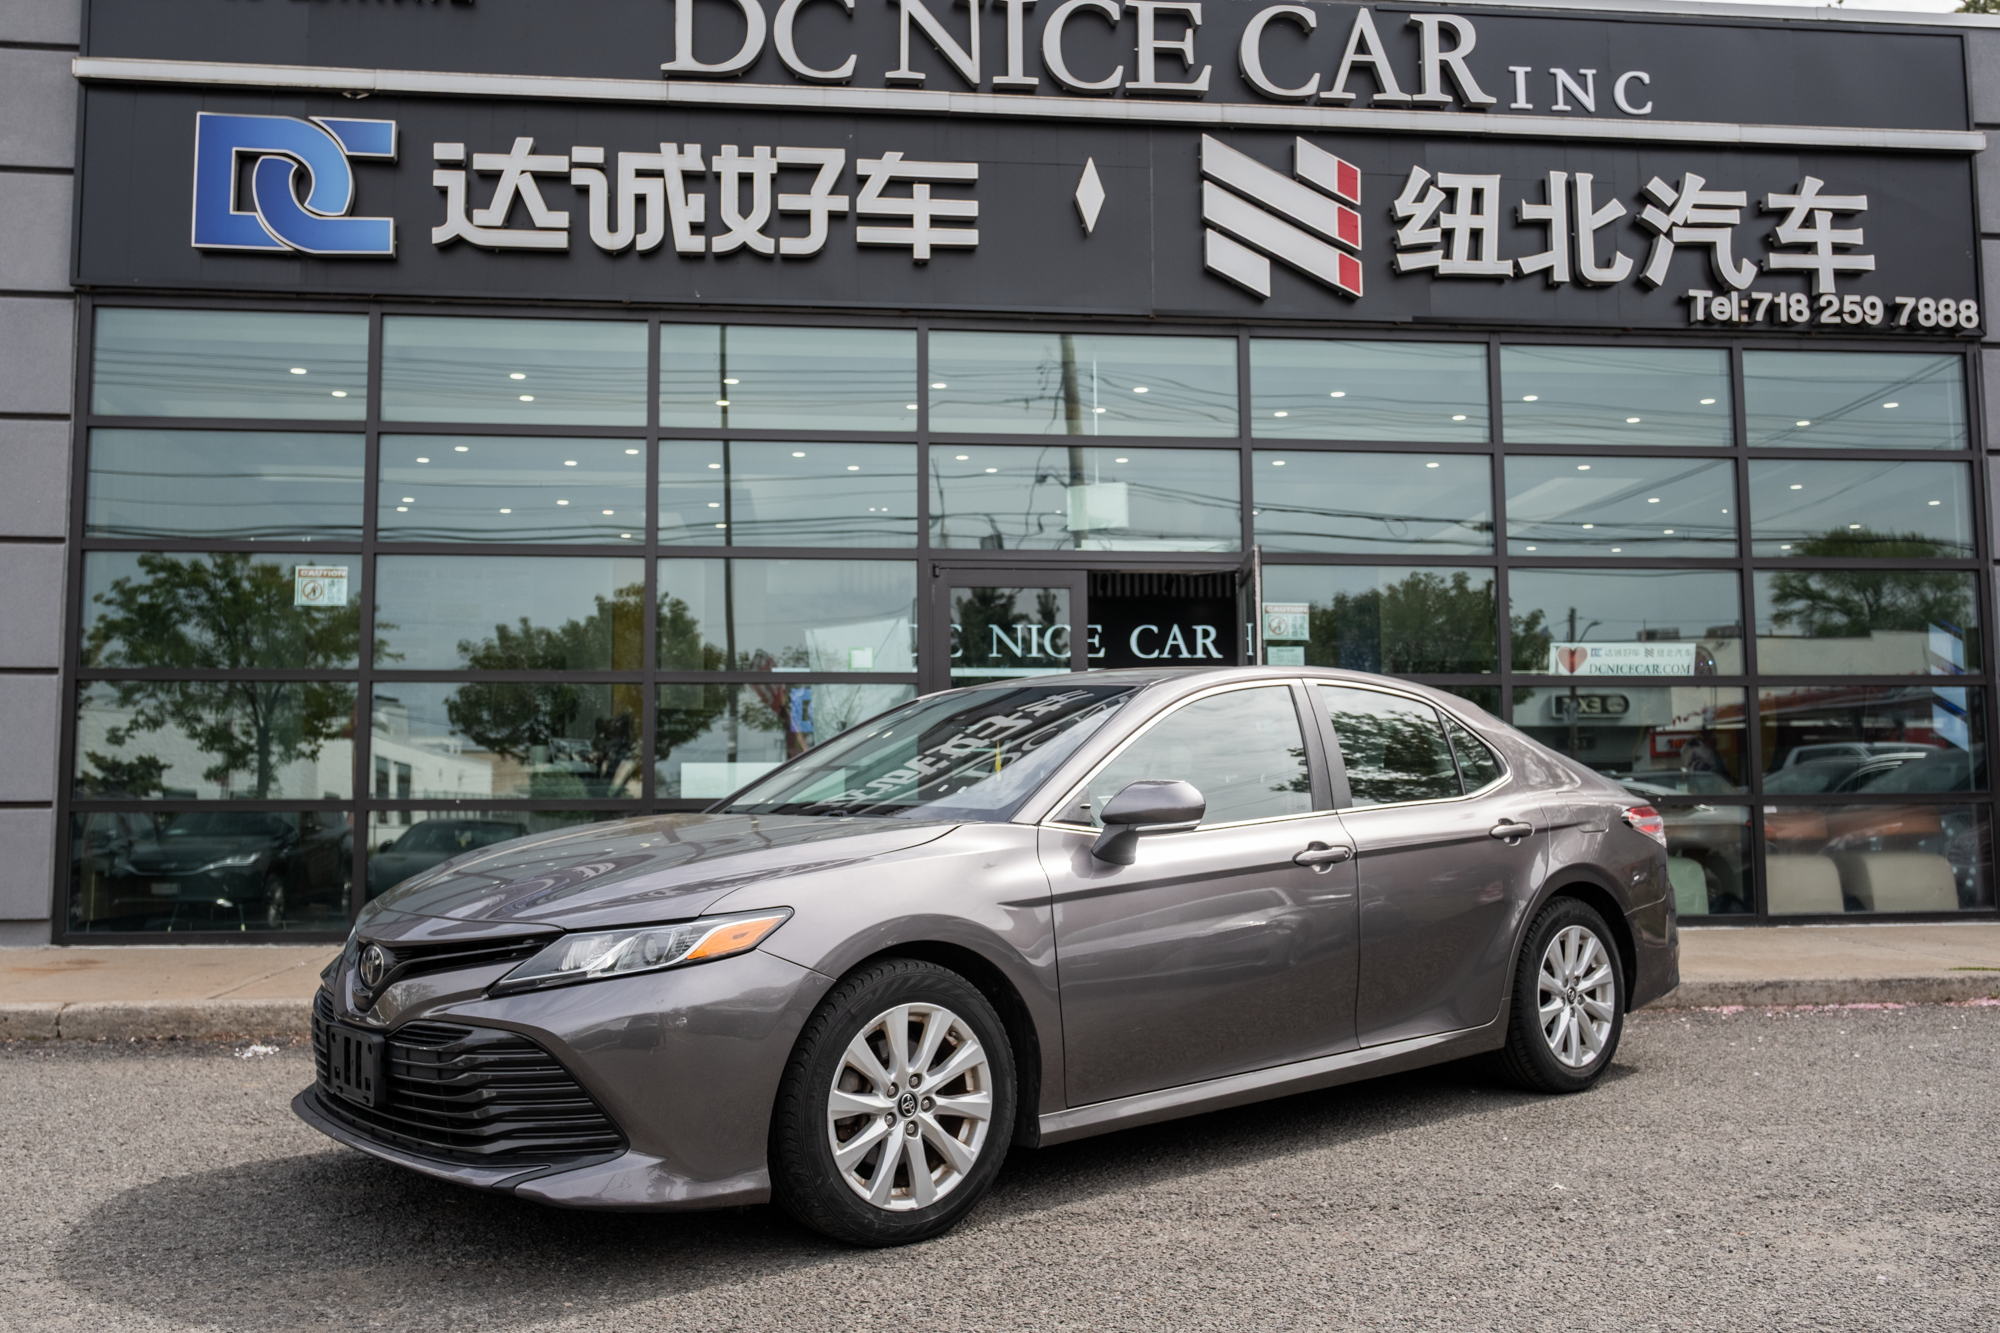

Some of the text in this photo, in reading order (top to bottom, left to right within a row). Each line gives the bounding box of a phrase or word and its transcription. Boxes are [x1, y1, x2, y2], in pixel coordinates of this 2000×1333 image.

[660, 0, 1654, 116] DC NICE CAR INC
[190, 111, 398, 257] DC
[431, 136, 979, 260] 达诚好车
[1393, 165, 1876, 295] 纽北汽车
[1819, 293, 1884, 326] 259
[1894, 296, 1980, 329] 7888
[299, 569, 347, 578] CAUTION
[1266, 605, 1308, 613] CAUTION
[988, 623, 1106, 658] NICE
[1129, 622, 1224, 659] CAR
[1588, 662, 1691, 675] DCNICECAR.COM
